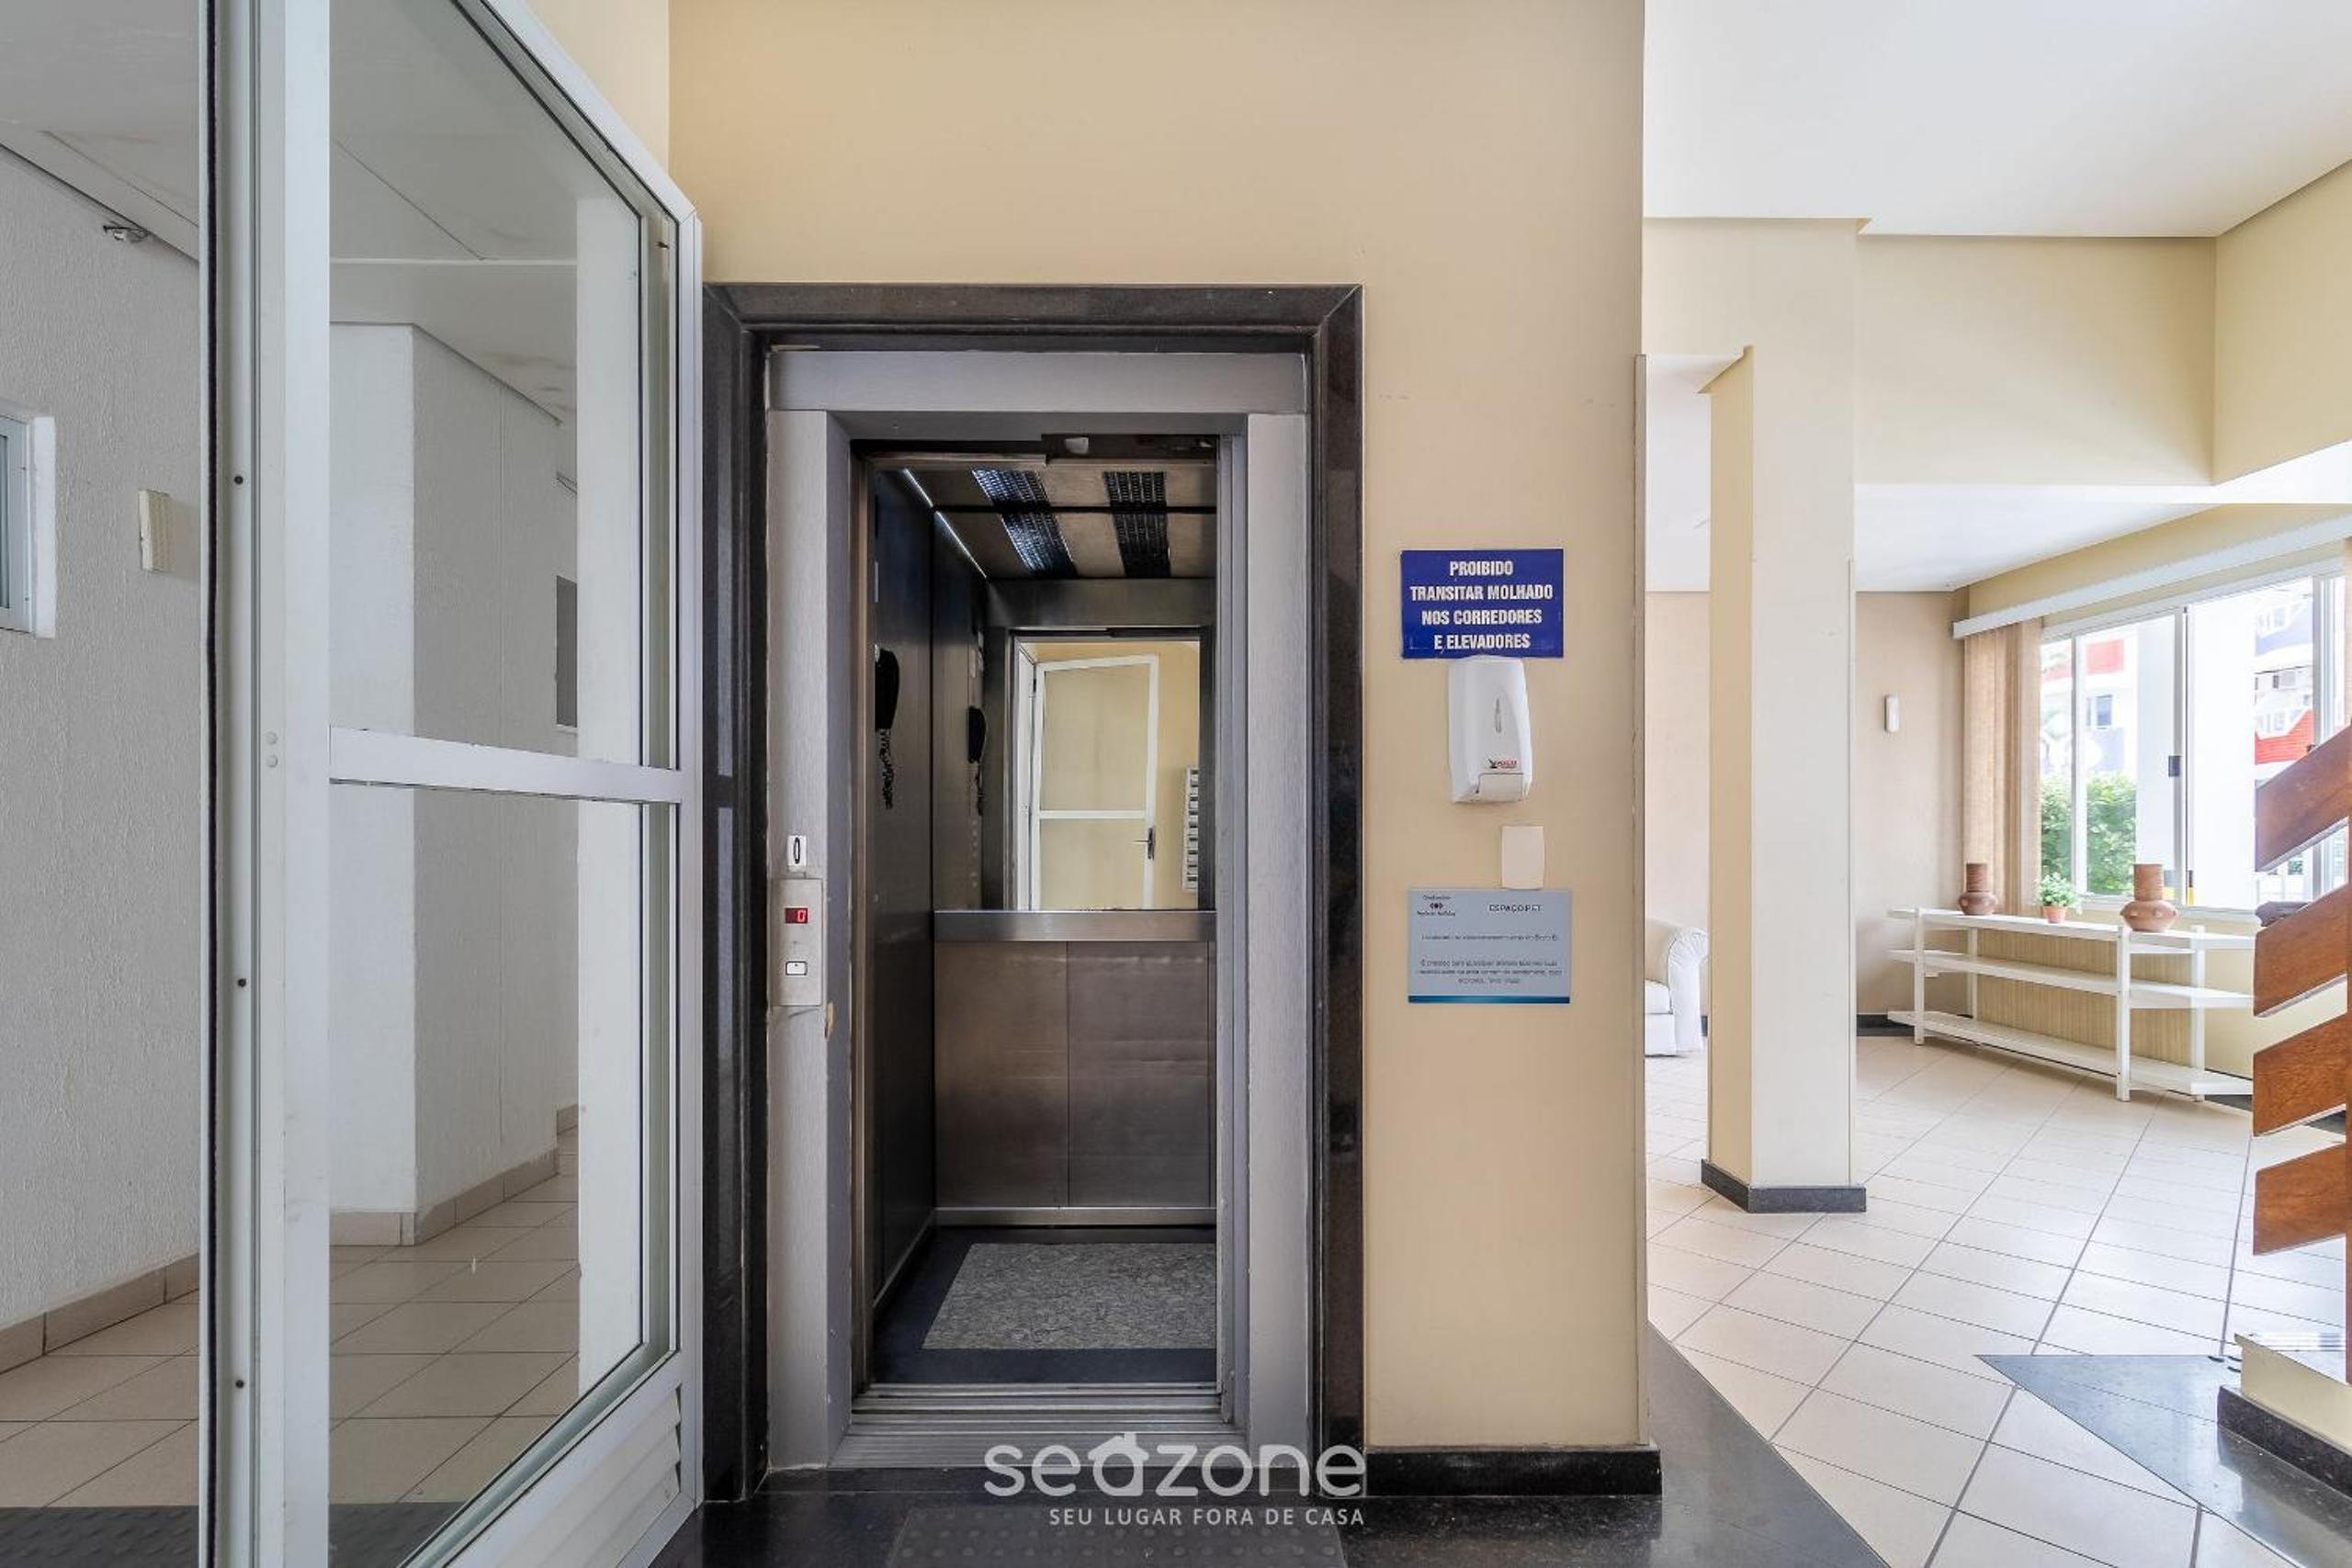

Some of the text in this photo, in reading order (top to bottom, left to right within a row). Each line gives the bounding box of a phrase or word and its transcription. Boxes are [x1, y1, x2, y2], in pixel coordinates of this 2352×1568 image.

[1450, 561, 1514, 576] PROIBIDO
[1409, 584, 1554, 601] TRANSITAR MOLHADO
[1421, 609, 1543, 625] NOS CORREDORES
[1434, 634, 1531, 649] E ELEVADORES
[797, 909, 806, 922] 0
